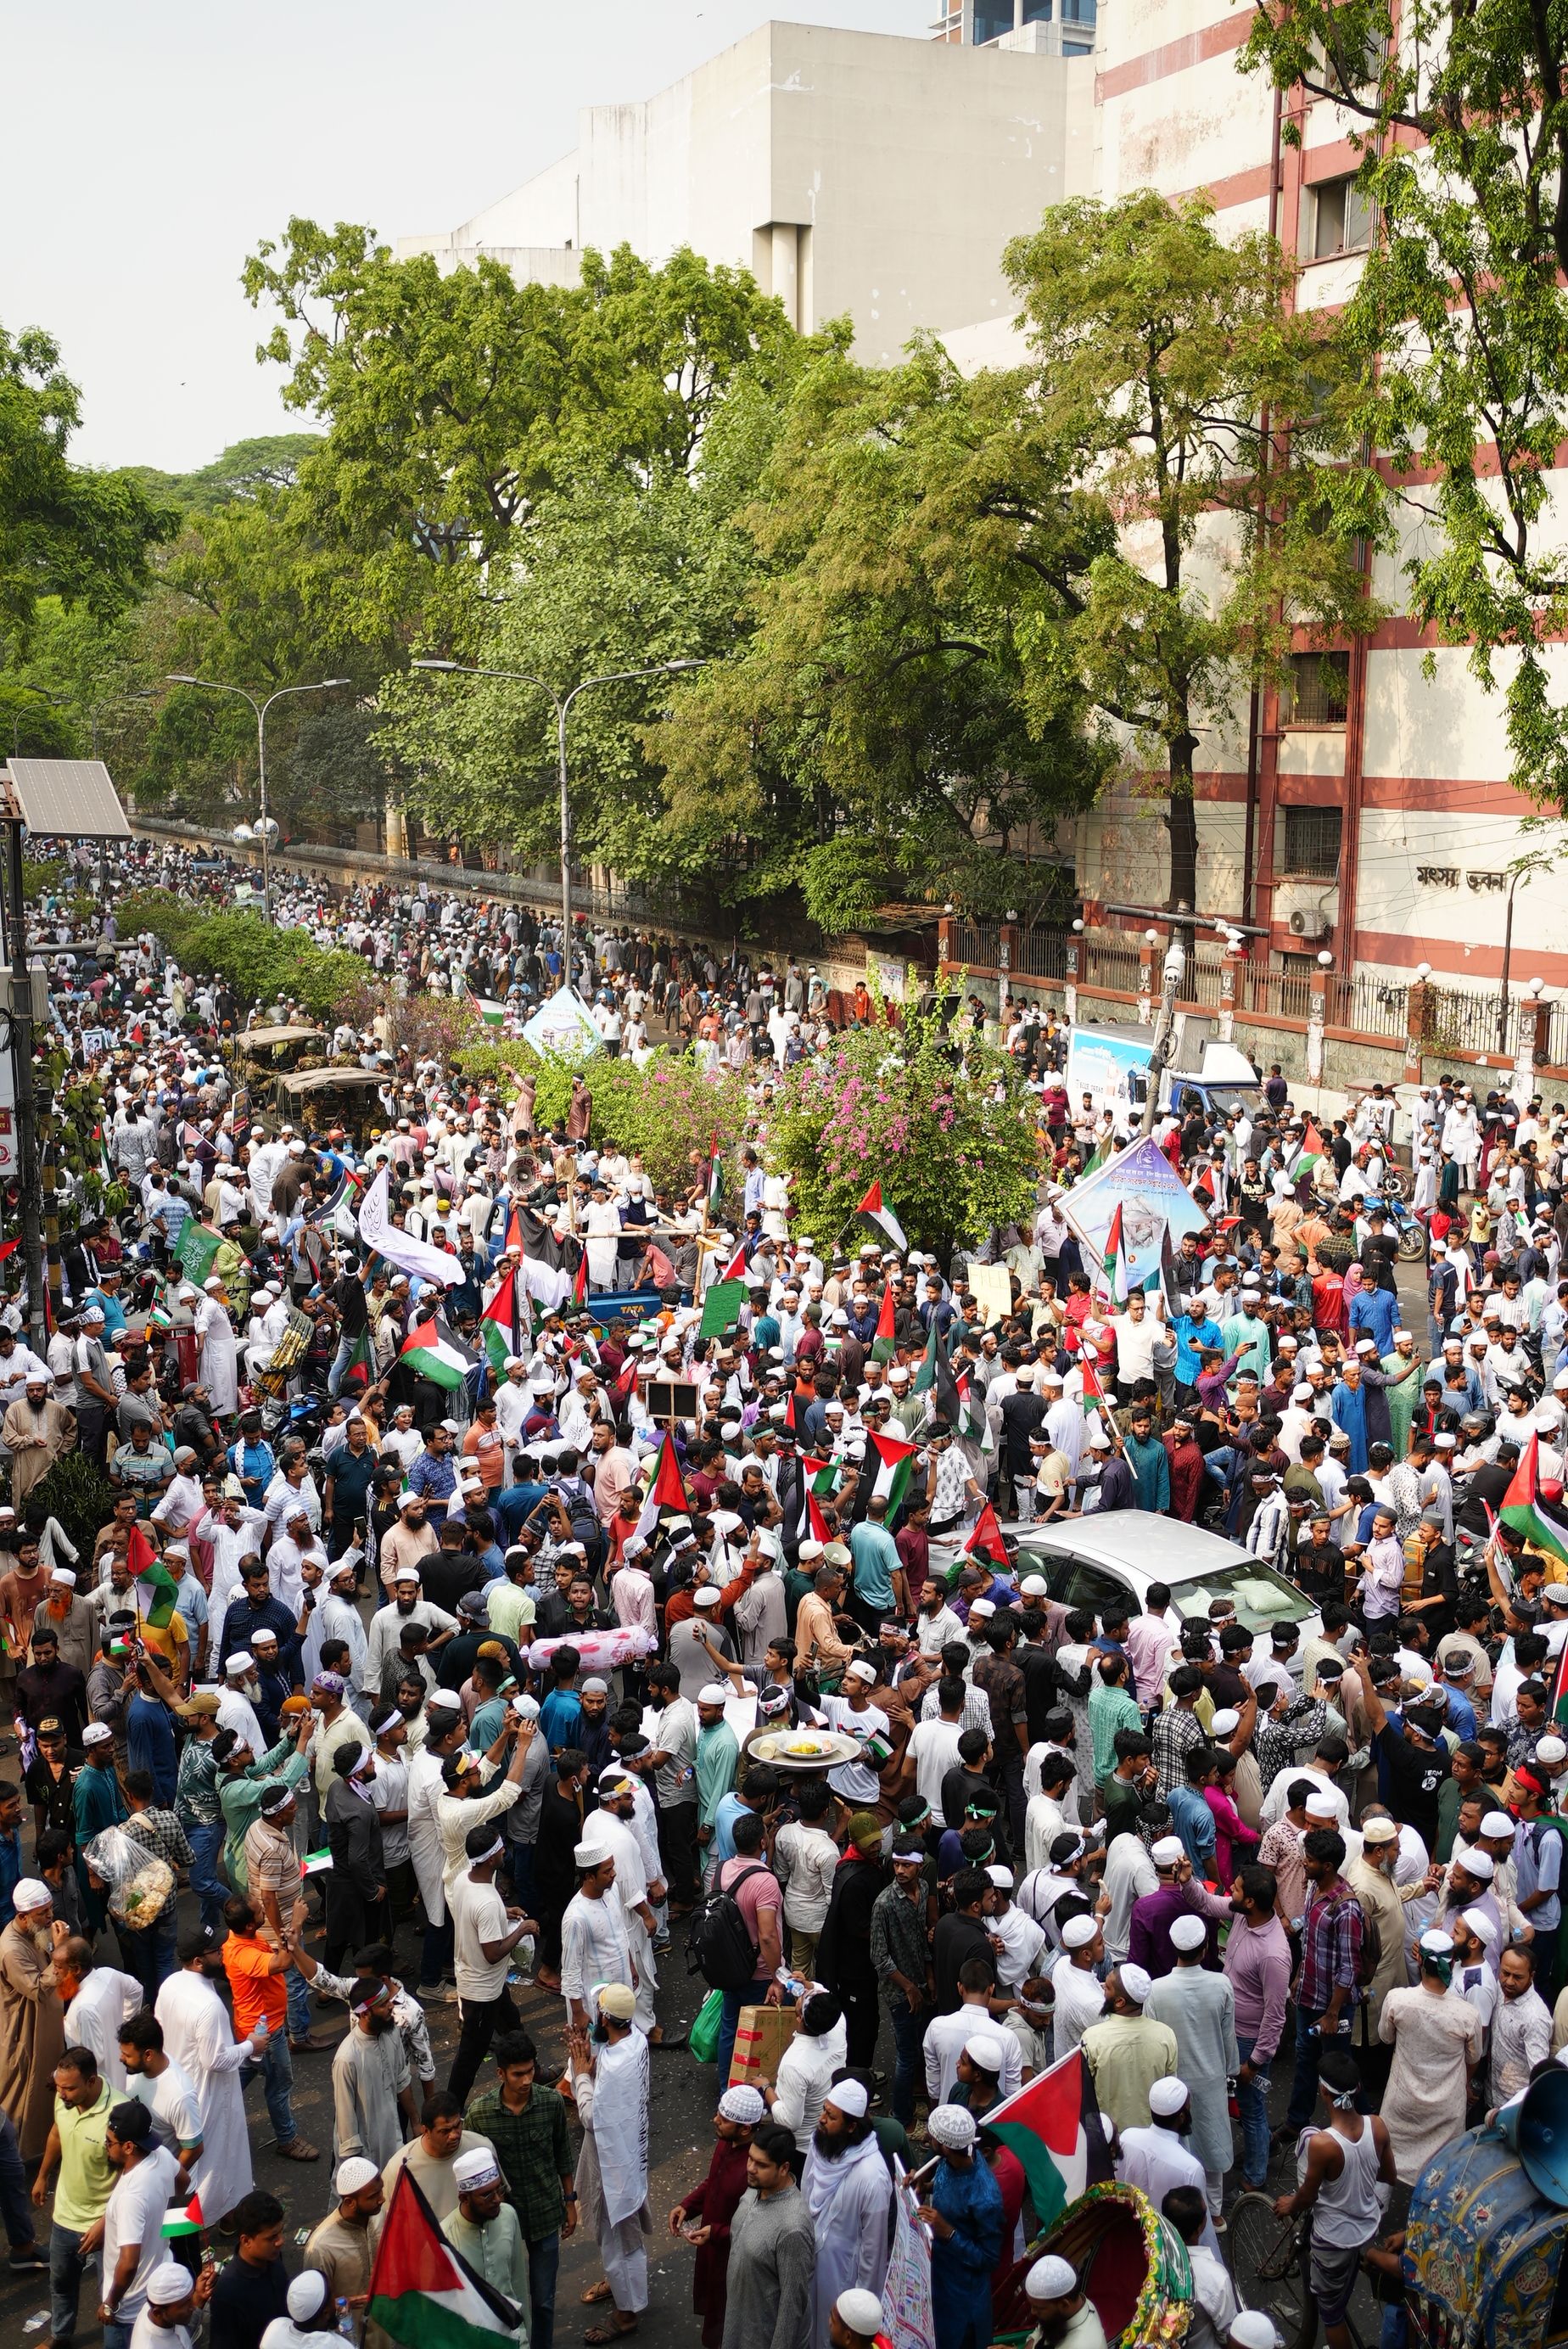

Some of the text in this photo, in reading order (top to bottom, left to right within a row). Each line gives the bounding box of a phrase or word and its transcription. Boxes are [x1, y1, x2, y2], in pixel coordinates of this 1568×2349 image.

[1416, 866, 1505, 892] মৎস্য ভবন
[620, 1304, 645, 1313] TATA
[1054, 1480, 1060, 1488] 3
